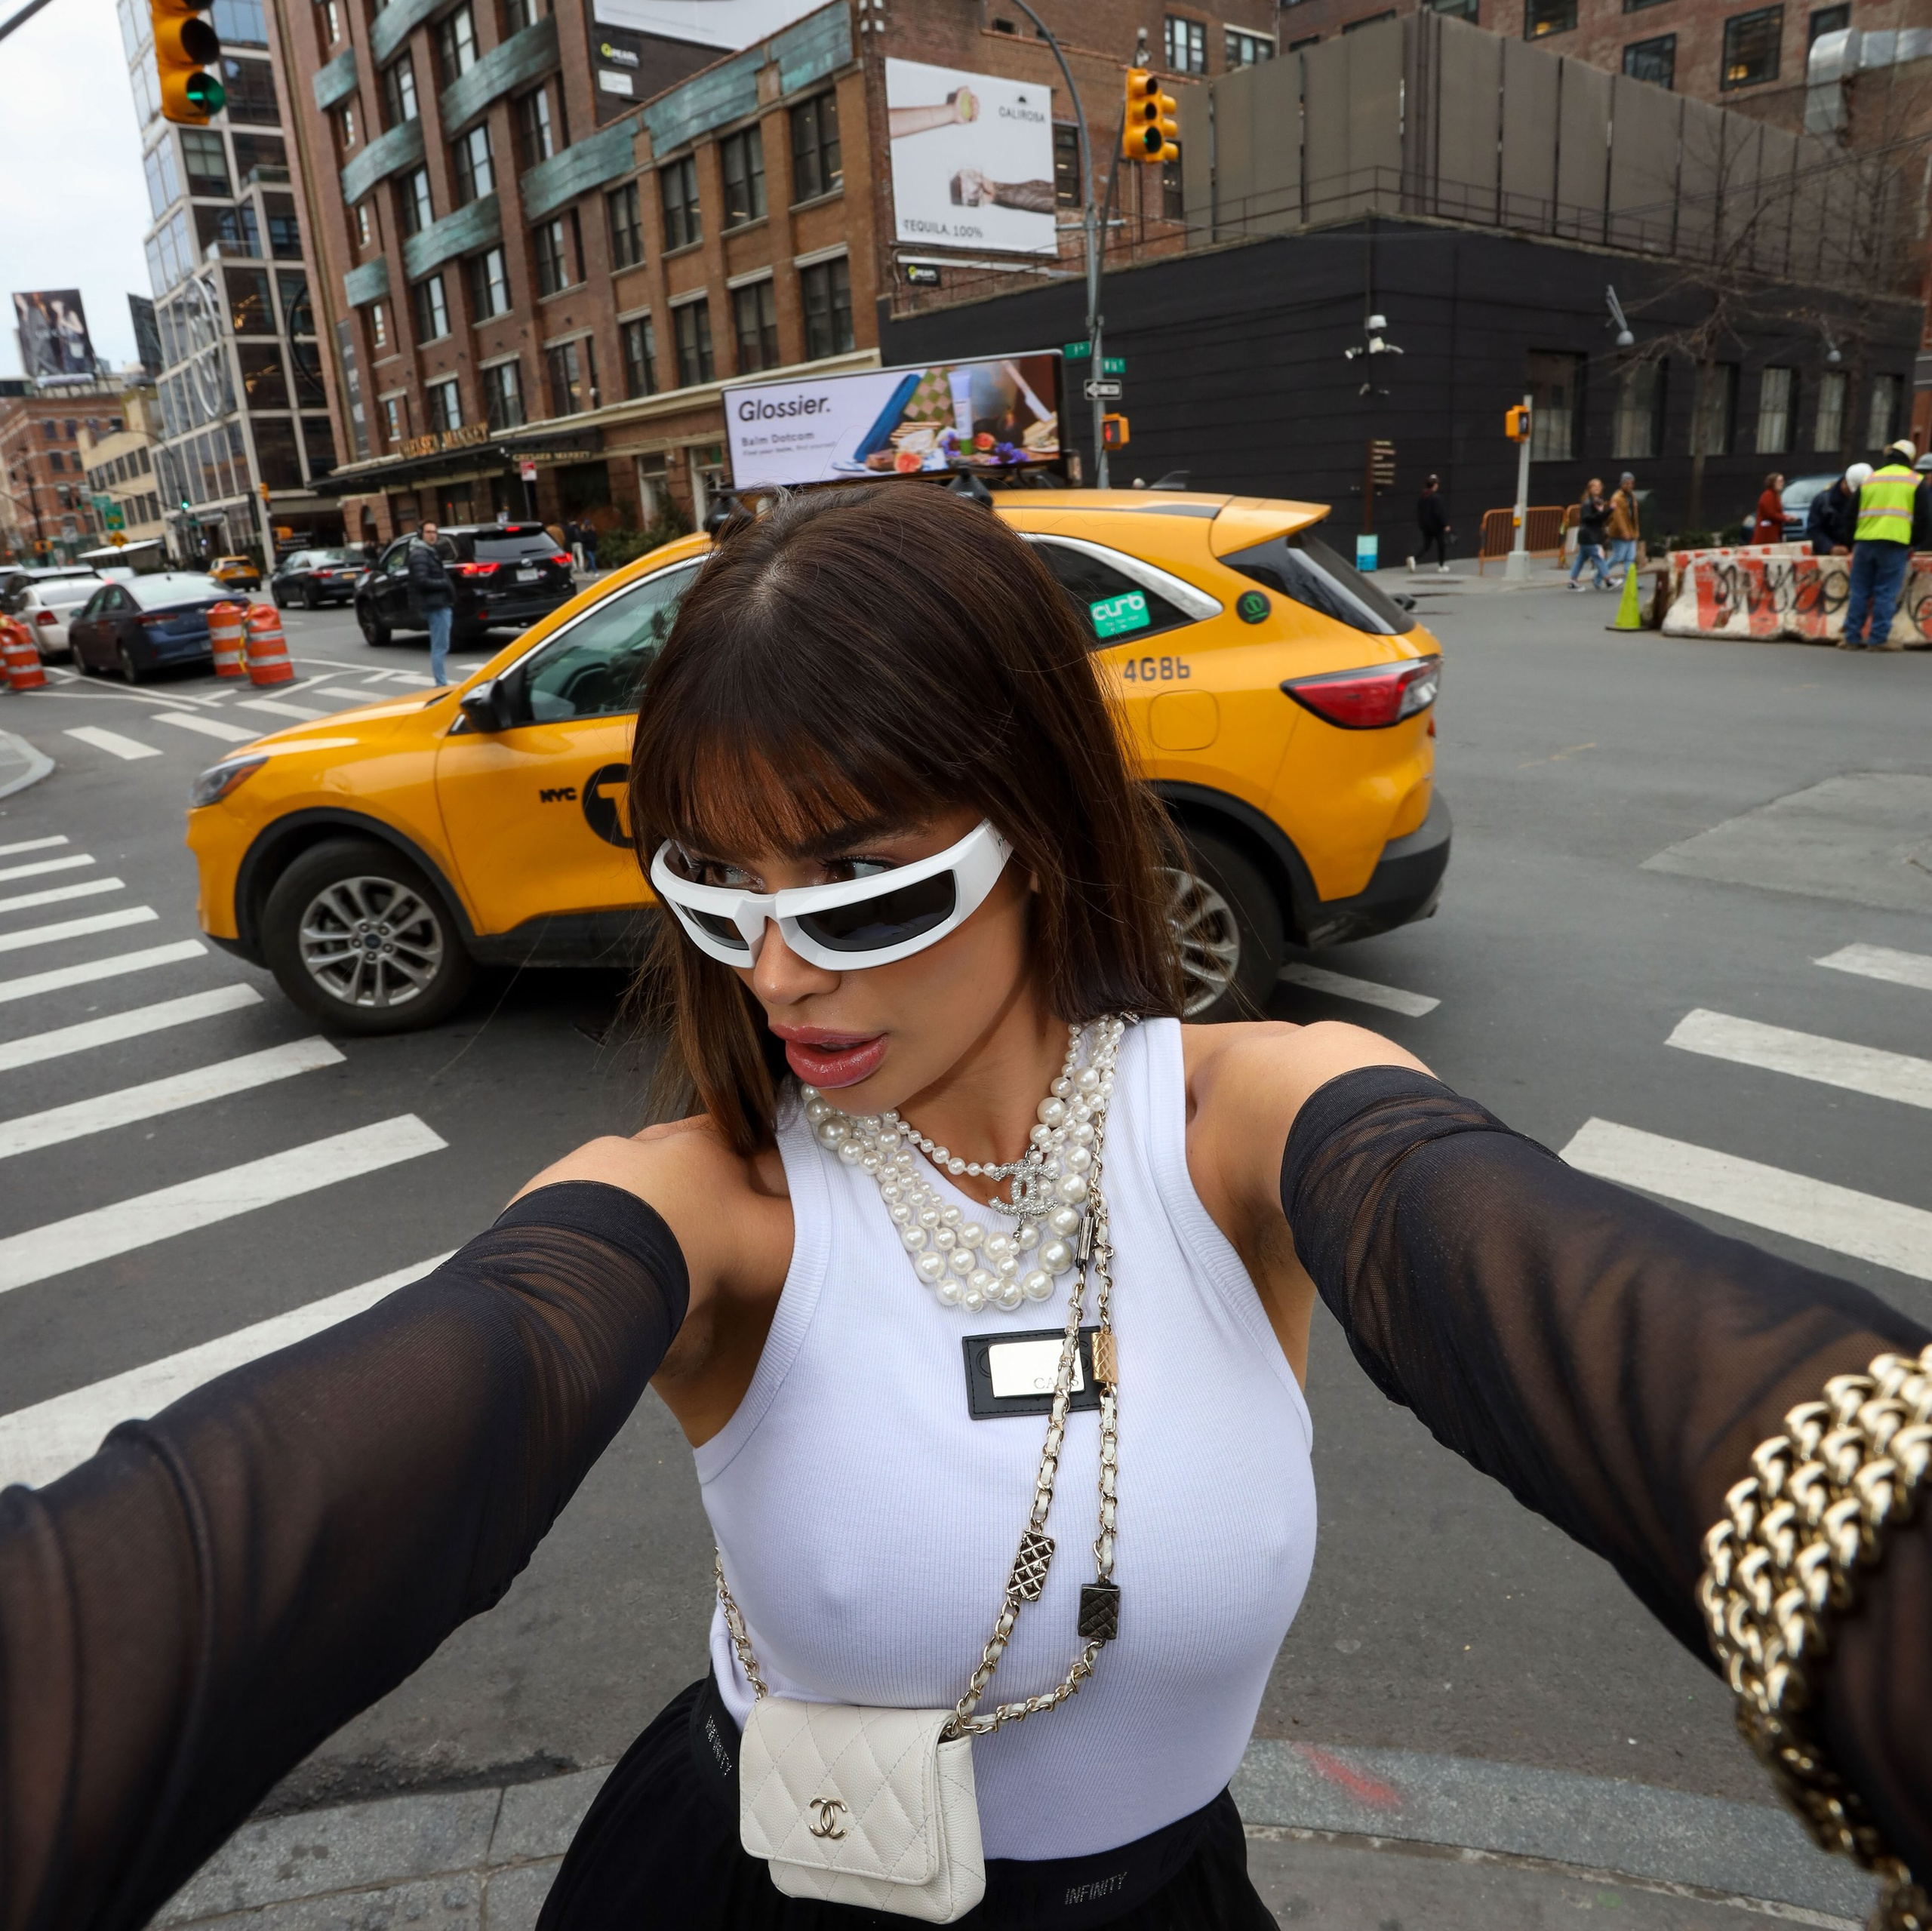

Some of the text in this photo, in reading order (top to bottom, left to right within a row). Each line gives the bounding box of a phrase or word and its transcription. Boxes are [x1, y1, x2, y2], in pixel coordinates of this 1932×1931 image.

[954, 226, 983, 238] 100%
[738, 395, 831, 422] Glossier.
[742, 432, 815, 447] Balm Dotcom
[1092, 595, 1146, 621] curb
[539, 787, 577, 804] NYC
[1033, 1376, 1079, 1390] CAS
[1064, 1871, 1128, 1905] INFINITY
